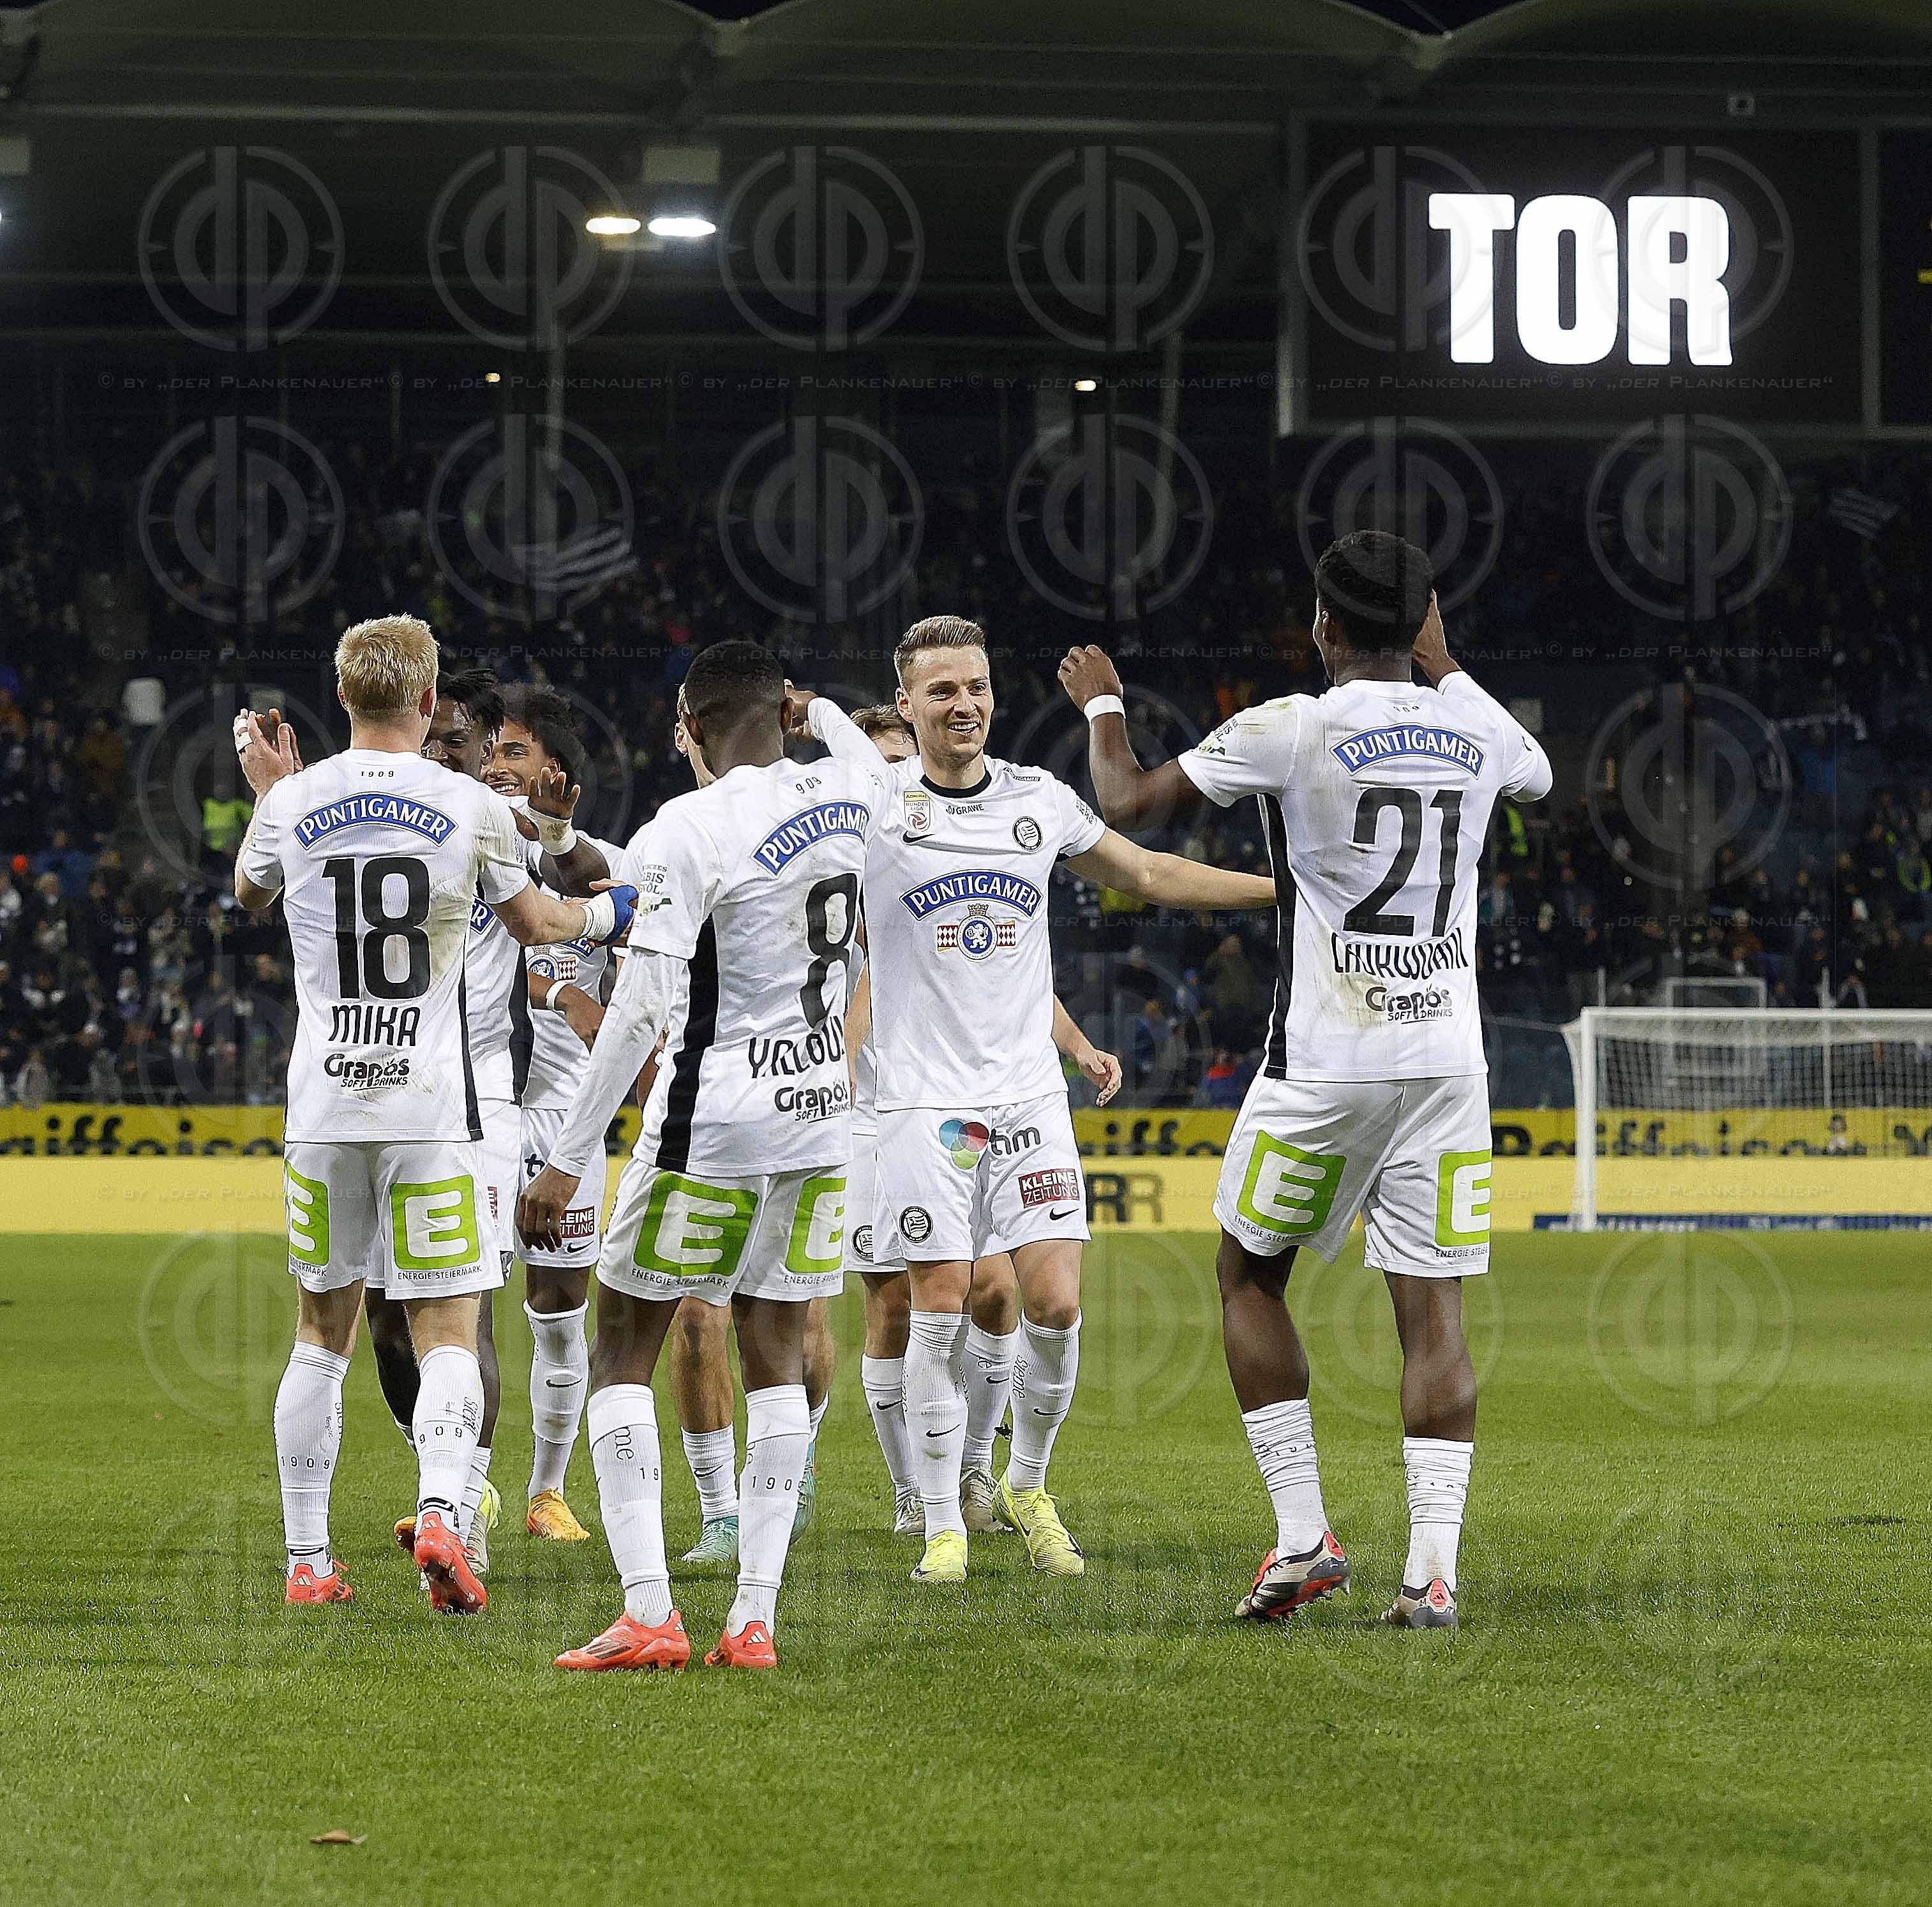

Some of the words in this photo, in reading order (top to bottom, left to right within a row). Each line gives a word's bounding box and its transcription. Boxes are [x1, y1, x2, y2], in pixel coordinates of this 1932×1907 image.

[1428, 193, 1733, 366] TOR
[1340, 729, 1481, 770] PUNTIGAMER
[361, 770, 395, 778] 1909
[299, 797, 448, 841] PUNTIGAMER
[956, 804, 984, 815] GRAWE
[1343, 787, 1465, 938] 21
[909, 874, 1039, 914] PUNTIGAMER
[321, 856, 431, 1000] 18
[799, 872, 858, 1029] 8
[1388, 1010, 1412, 1021] SOFT
[1419, 1008, 1453, 1019] DRINKS
[328, 1005, 421, 1047] MIKA
[341, 1079, 366, 1088] SOFT
[373, 1076, 408, 1087] DRINKS
[795, 1108, 819, 1121] SOFT
[1021, 1171, 1077, 1191] KLEINE
[1024, 1185, 1079, 1204] ZEITUNG
[1234, 1215, 1264, 1238] ENERGIE
[1435, 1249, 1469, 1258] ENERGIE
[397, 1272, 432, 1281] ENERGIE
[435, 1265, 483, 1280] STEIERMARK
[631, 1268, 671, 1286] ENERGIE
[783, 1275, 821, 1285] ENERGIE
[281, 1455, 331, 1470] 1909
